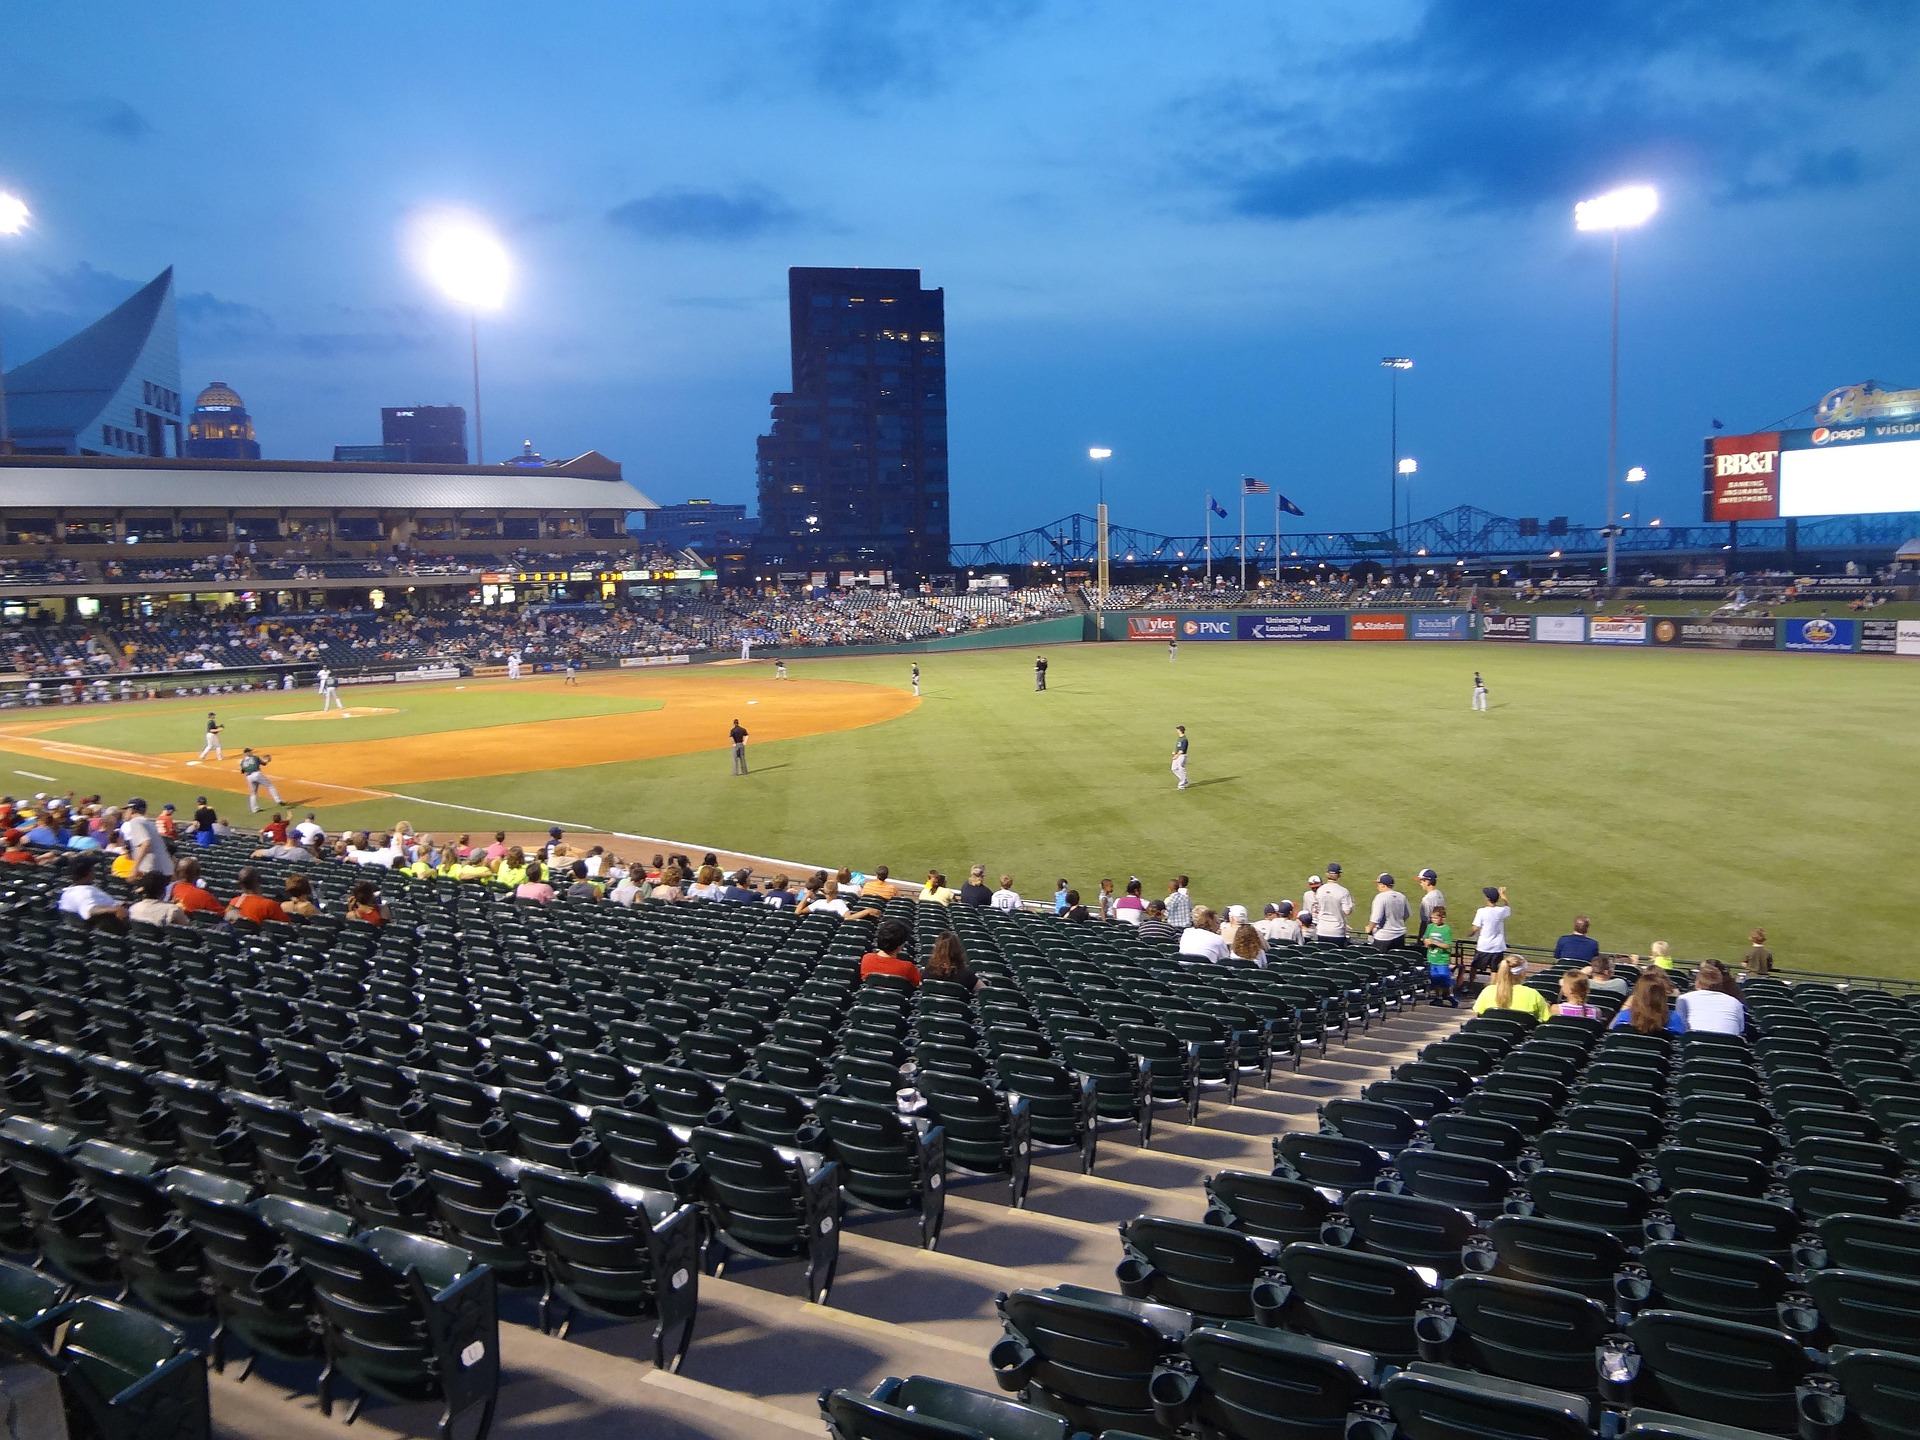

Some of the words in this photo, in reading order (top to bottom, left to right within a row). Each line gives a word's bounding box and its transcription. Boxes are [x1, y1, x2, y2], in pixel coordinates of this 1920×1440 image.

[1830, 426, 1866, 441] pepsi
[1714, 451, 1779, 477] BB&T
[1819, 577, 1873, 585] CHEVROLET
[1128, 618, 1175, 633] Wyler
[1265, 616, 1302, 624] University
[1417, 618, 1451, 628] Kindred
[1199, 621, 1231, 633] PNC
[1300, 625, 1331, 633] Hospital
[1681, 624, 1775, 636] BROWN-FORMAN
